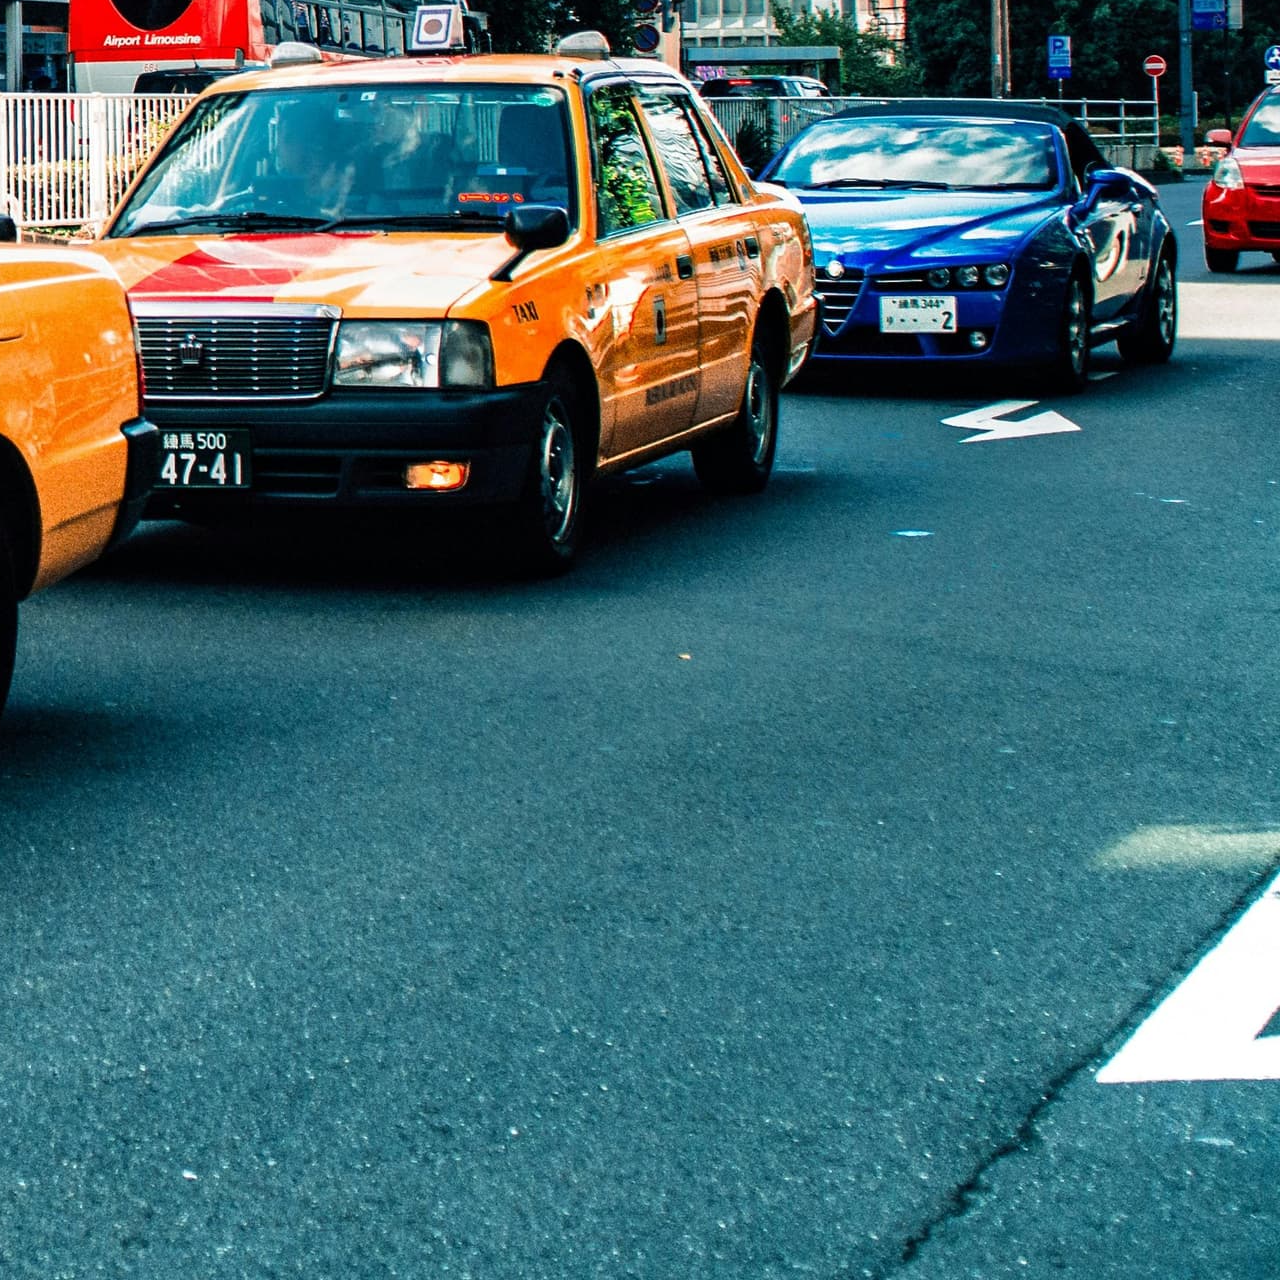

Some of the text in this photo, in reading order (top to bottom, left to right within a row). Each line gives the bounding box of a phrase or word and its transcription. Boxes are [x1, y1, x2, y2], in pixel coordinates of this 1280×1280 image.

[104, 32, 201, 48] Airport Limousine
[512, 300, 539, 324] TAXI
[161, 452, 242, 485] 47-41
